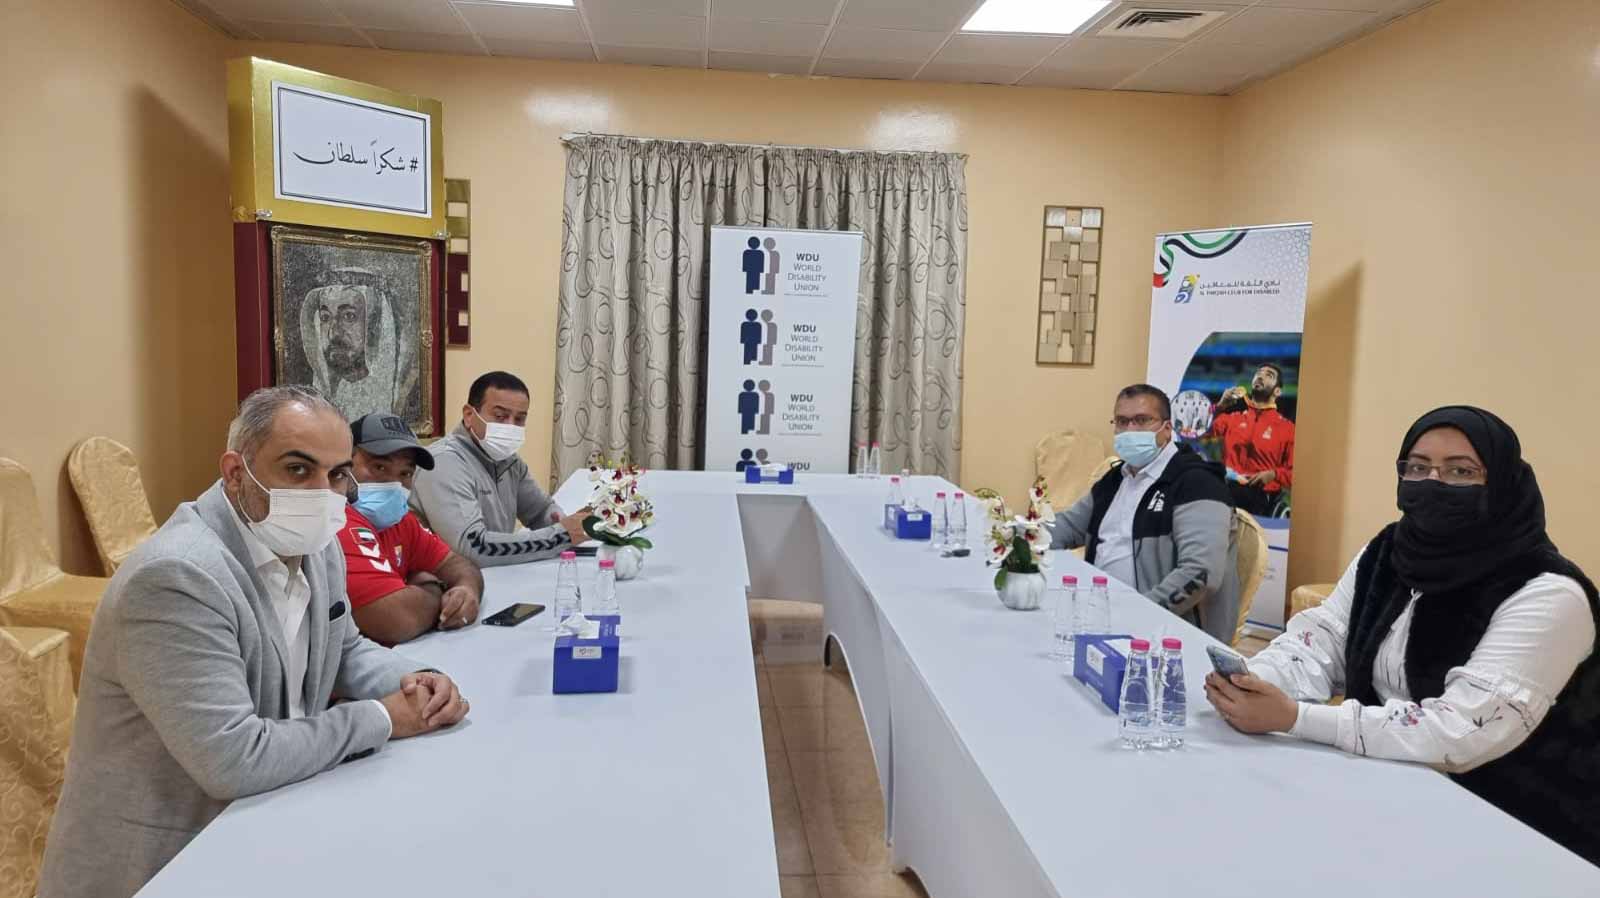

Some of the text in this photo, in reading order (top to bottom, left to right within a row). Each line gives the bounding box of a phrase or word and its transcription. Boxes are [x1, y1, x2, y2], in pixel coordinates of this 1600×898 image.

[292, 141, 368, 165] سلطان
[796, 252, 820, 261] WDU
[793, 263, 822, 271] WORLD
[787, 272, 827, 281] DISABILITY
[794, 282, 820, 291] UNION
[793, 324, 816, 333] WDU
[790, 333, 818, 343] WORLD
[784, 343, 824, 353] DISABILITY
[791, 353, 816, 362] UNION
[790, 393, 814, 402] WDU
[787, 403, 816, 412] WORLD
[782, 412, 820, 421] DISABILITY
[788, 423, 814, 431] UNION
